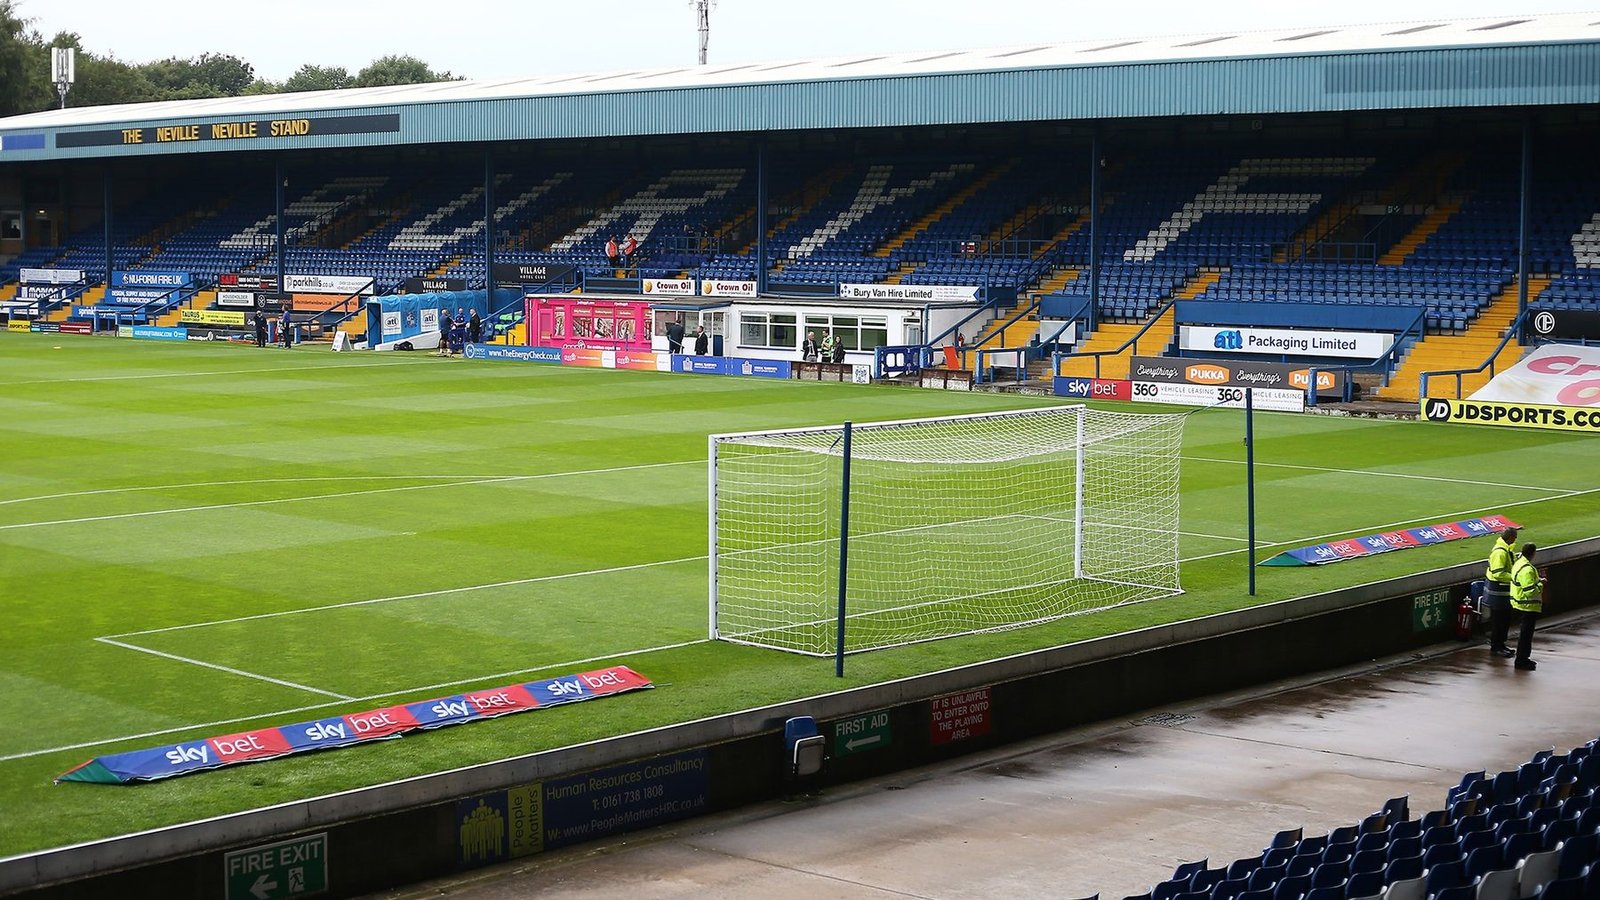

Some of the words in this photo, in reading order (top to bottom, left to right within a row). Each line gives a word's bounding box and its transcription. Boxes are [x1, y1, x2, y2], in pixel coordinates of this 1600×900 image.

[122, 129, 142, 144] THE
[156, 126, 199, 142] NEVILLE
[211, 122, 256, 139] NEVILLE
[270, 120, 309, 136] STAND
[174, 276, 182, 284] UK
[519, 267, 546, 275] VILLAGE
[422, 281, 447, 289] VILLAGE
[656, 282, 678, 290] Crown
[680, 282, 691, 290] Oil
[742, 283, 753, 291] Oil
[854, 288, 870, 298] Bury
[872, 289, 886, 297] Van
[888, 289, 903, 298] Hire
[904, 290, 932, 298] Limited
[1214, 330, 1243, 350] atl
[1248, 335, 1308, 350] Packaging
[1312, 337, 1356, 350] Limited
[488, 350, 561, 360] www.TheEnergyCheck.co.uk
[1137, 364, 1178, 378] Everything's
[1190, 368, 1225, 380] PUKKA
[1236, 370, 1281, 384] Everything's
[1294, 374, 1330, 386] PUKA
[1068, 379, 1090, 396] sky
[1094, 382, 1117, 395] bet
[1134, 384, 1158, 396] 360
[1217, 388, 1242, 401] 360
[1429, 402, 1449, 418] JD
[1314, 548, 1333, 558] sky
[1336, 541, 1356, 555] bet
[1367, 536, 1387, 548] sky
[1388, 530, 1405, 544] bet
[1419, 528, 1438, 541] sky
[1439, 523, 1458, 537] bet
[1468, 520, 1486, 532] sky
[1485, 516, 1505, 529] bet
[1414, 594, 1431, 609] FIRE
[1433, 590, 1449, 604] EXIT
[932, 700, 940, 710] IT
[942, 698, 949, 708] IS
[952, 690, 988, 706] UNLAWFUL
[166, 744, 208, 764] sky
[213, 732, 264, 756] bet
[306, 722, 346, 741] sky
[350, 712, 397, 732] bet
[432, 699, 469, 718] sky
[472, 692, 516, 709] bet
[547, 679, 582, 696] sky
[583, 671, 626, 688] bet
[932, 711, 942, 720] TO
[944, 706, 968, 718] ENTER
[970, 701, 989, 713] ONTO
[836, 717, 867, 736] FIRST
[871, 713, 889, 728] AID
[938, 720, 952, 732] THE
[954, 714, 983, 728] PLAYING
[952, 728, 970, 741] AREA
[546, 782, 586, 800] Human
[589, 770, 642, 791] Resources
[644, 757, 704, 779] Consultancy
[592, 800, 599, 810] T:
[602, 794, 622, 809] 0161
[623, 791, 640, 802] 738
[644, 785, 664, 799] 1808
[512, 796, 525, 848] People
[528, 788, 539, 847] Matters
[563, 795, 704, 837] www.PeopleMattersHRC.co.uk
[230, 851, 274, 876] FIRE
[280, 841, 322, 866] EXIT
